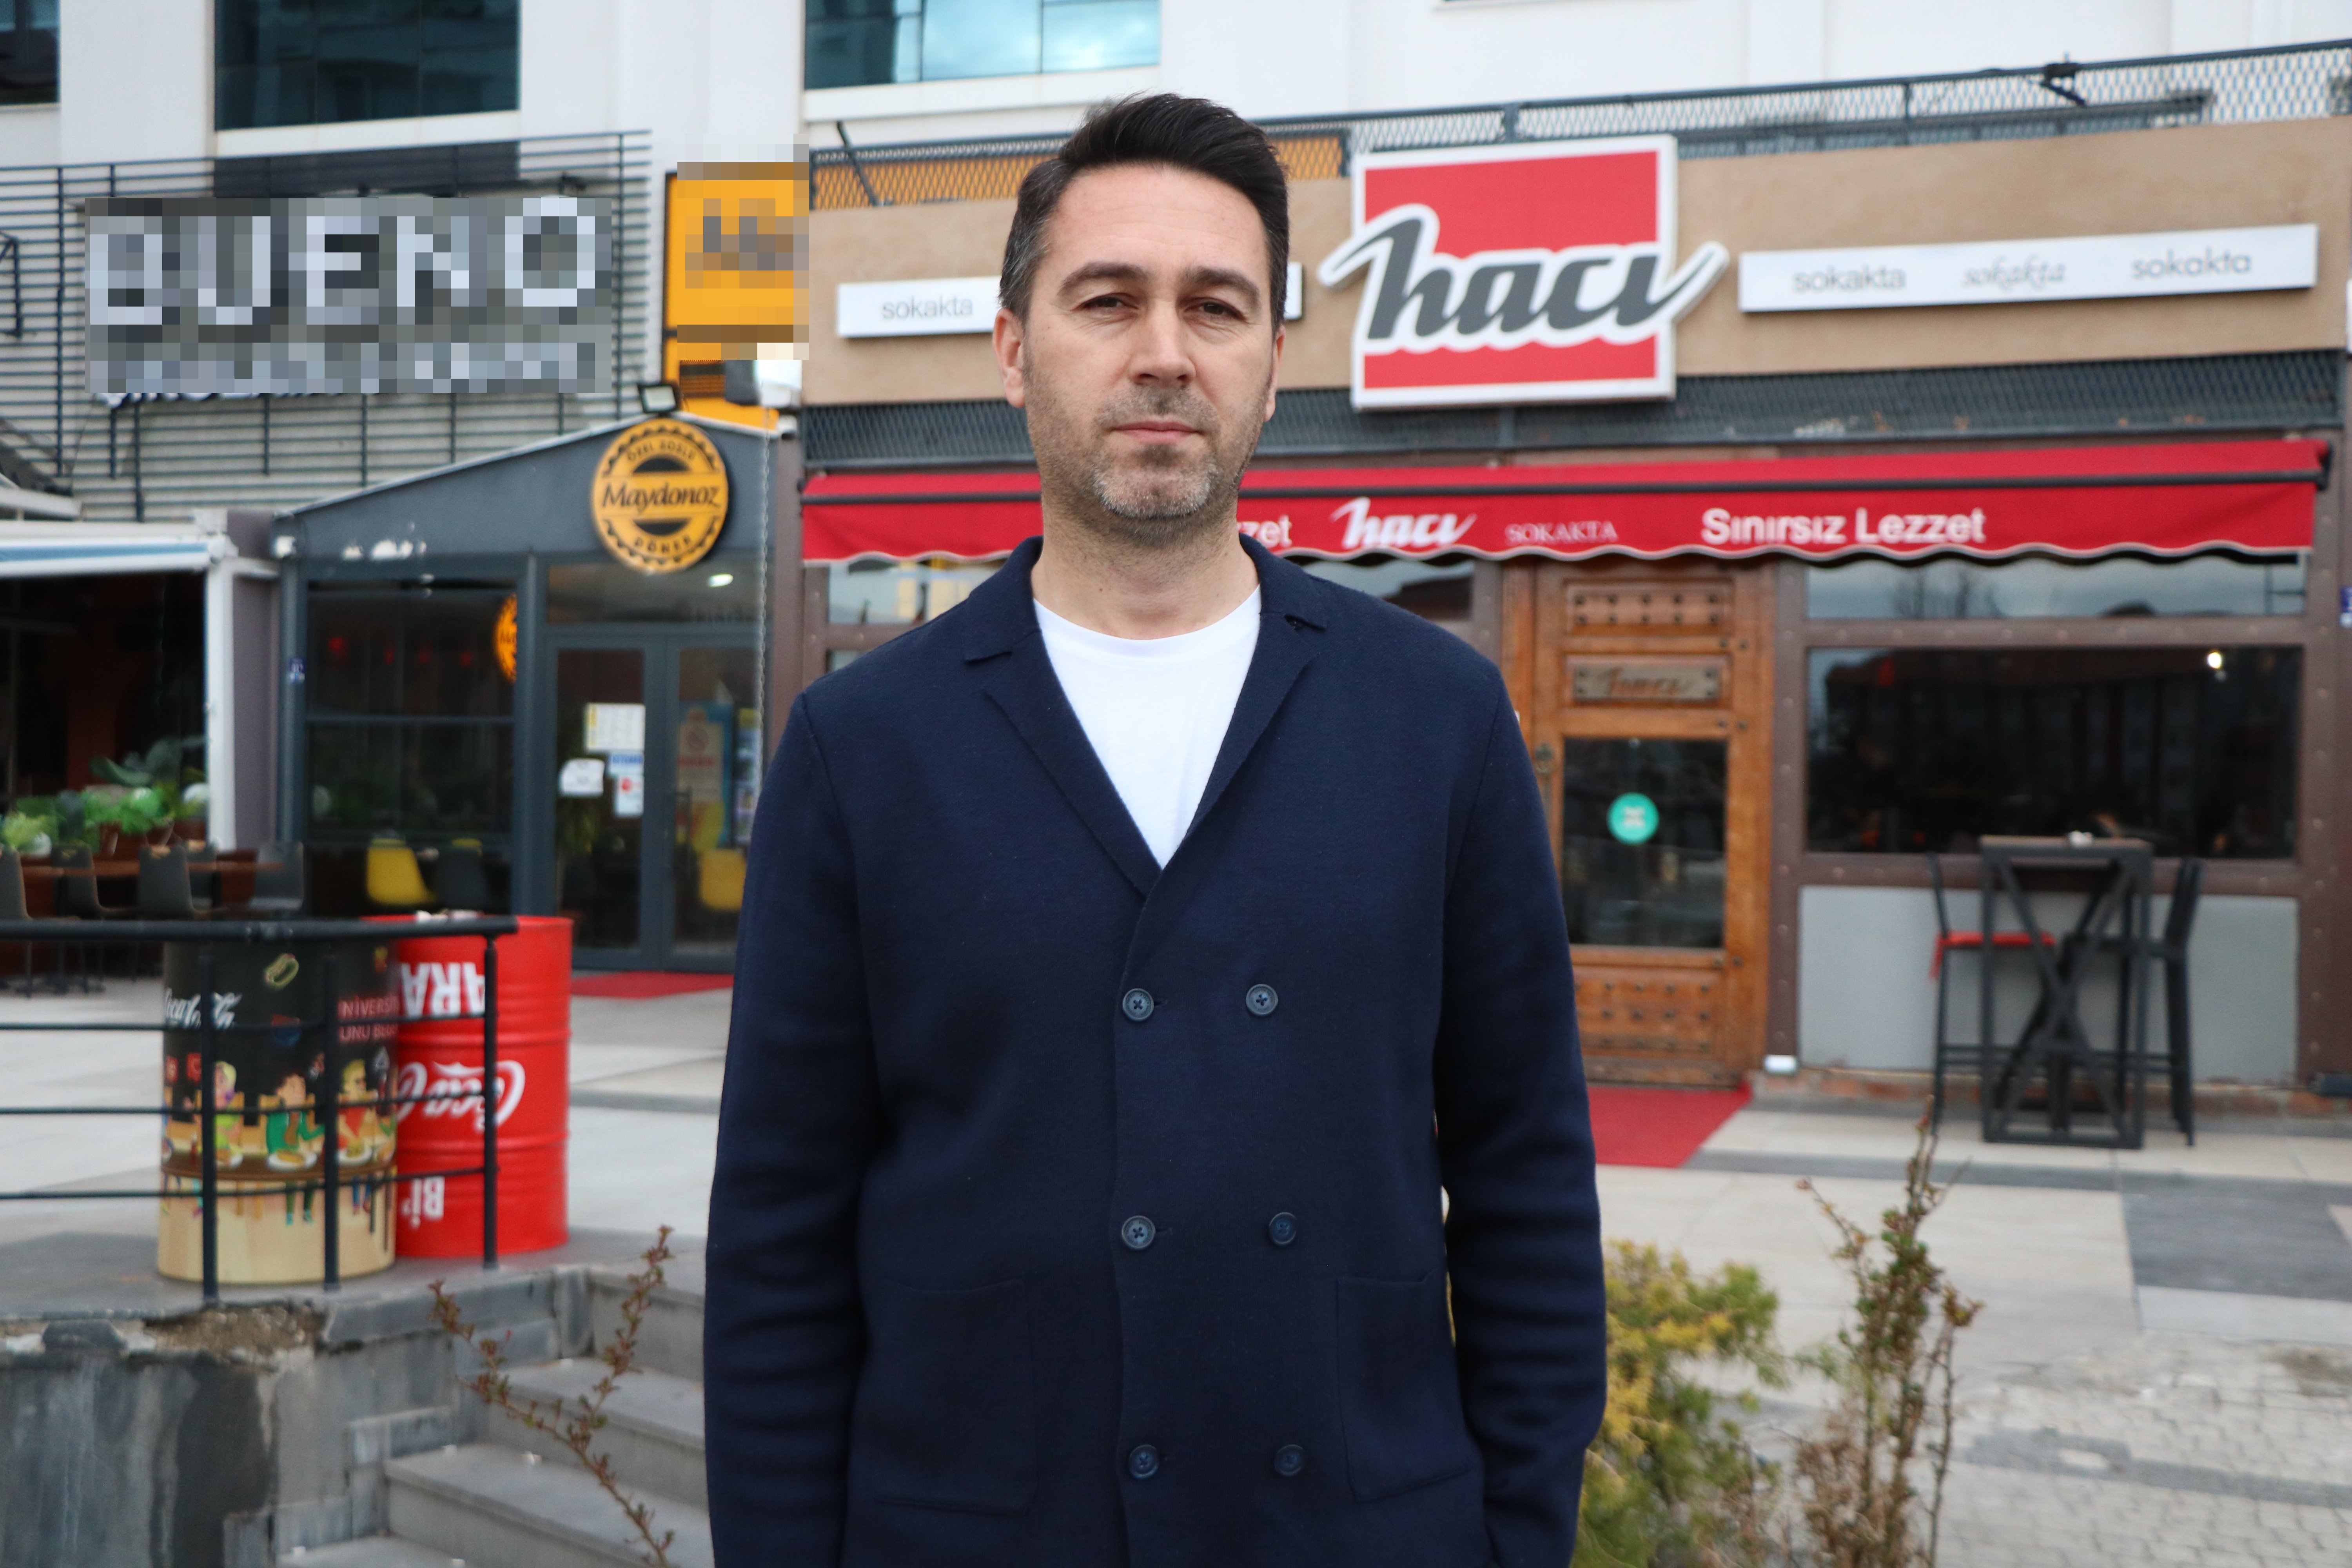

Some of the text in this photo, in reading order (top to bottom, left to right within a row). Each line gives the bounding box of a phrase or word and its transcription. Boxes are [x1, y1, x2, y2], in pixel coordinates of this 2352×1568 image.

[1792, 246, 2252, 293] sokakta sokakta sokakta
[882, 296, 973, 320] sokakta
[602, 482, 722, 513] Maydonoz
[1237, 514, 1293, 548] zet
[1504, 521, 1618, 544] SOKAKTA
[1701, 508, 1847, 544] Sınırsız
[1855, 506, 1987, 544] Lezzet
